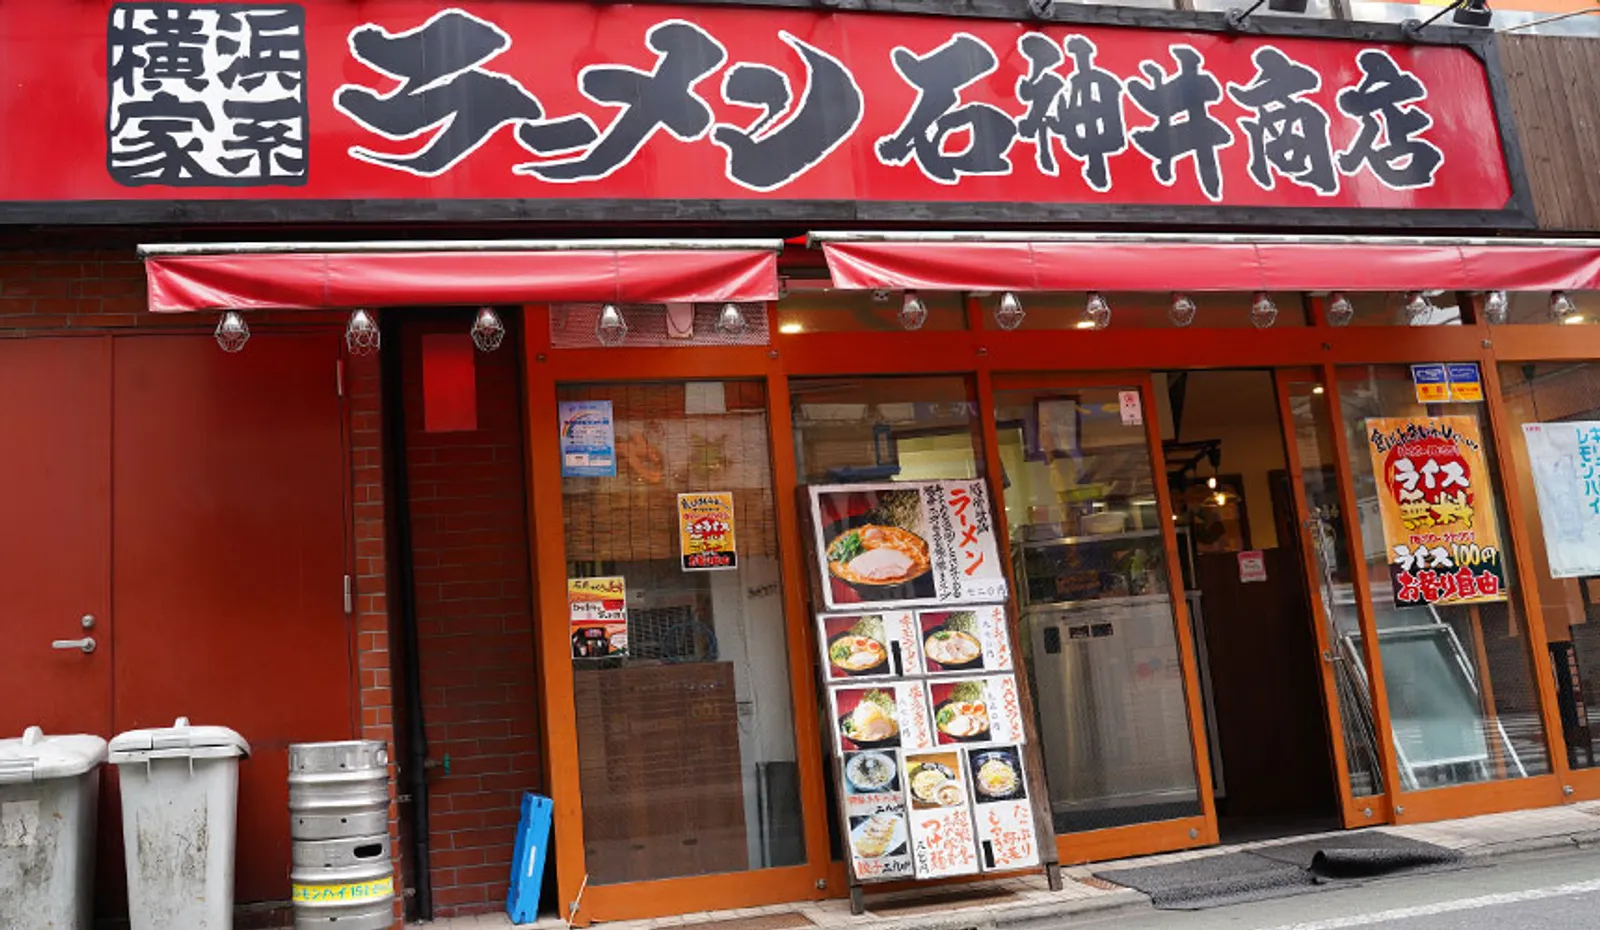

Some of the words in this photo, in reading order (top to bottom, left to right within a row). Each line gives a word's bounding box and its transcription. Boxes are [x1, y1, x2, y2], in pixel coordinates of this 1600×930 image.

[110, 7, 303, 97] 横浜
[109, 93, 304, 180] 家系
[333, 8, 864, 191] ラーメン
[876, 33, 1445, 201] 石神井商店
[1394, 457, 1470, 491] ライス
[1399, 489, 1475, 530] 無料
[1576, 427, 1600, 515] レモンハイ
[947, 487, 985, 577] ラーメン
[1397, 565, 1499, 602] お替り自由
